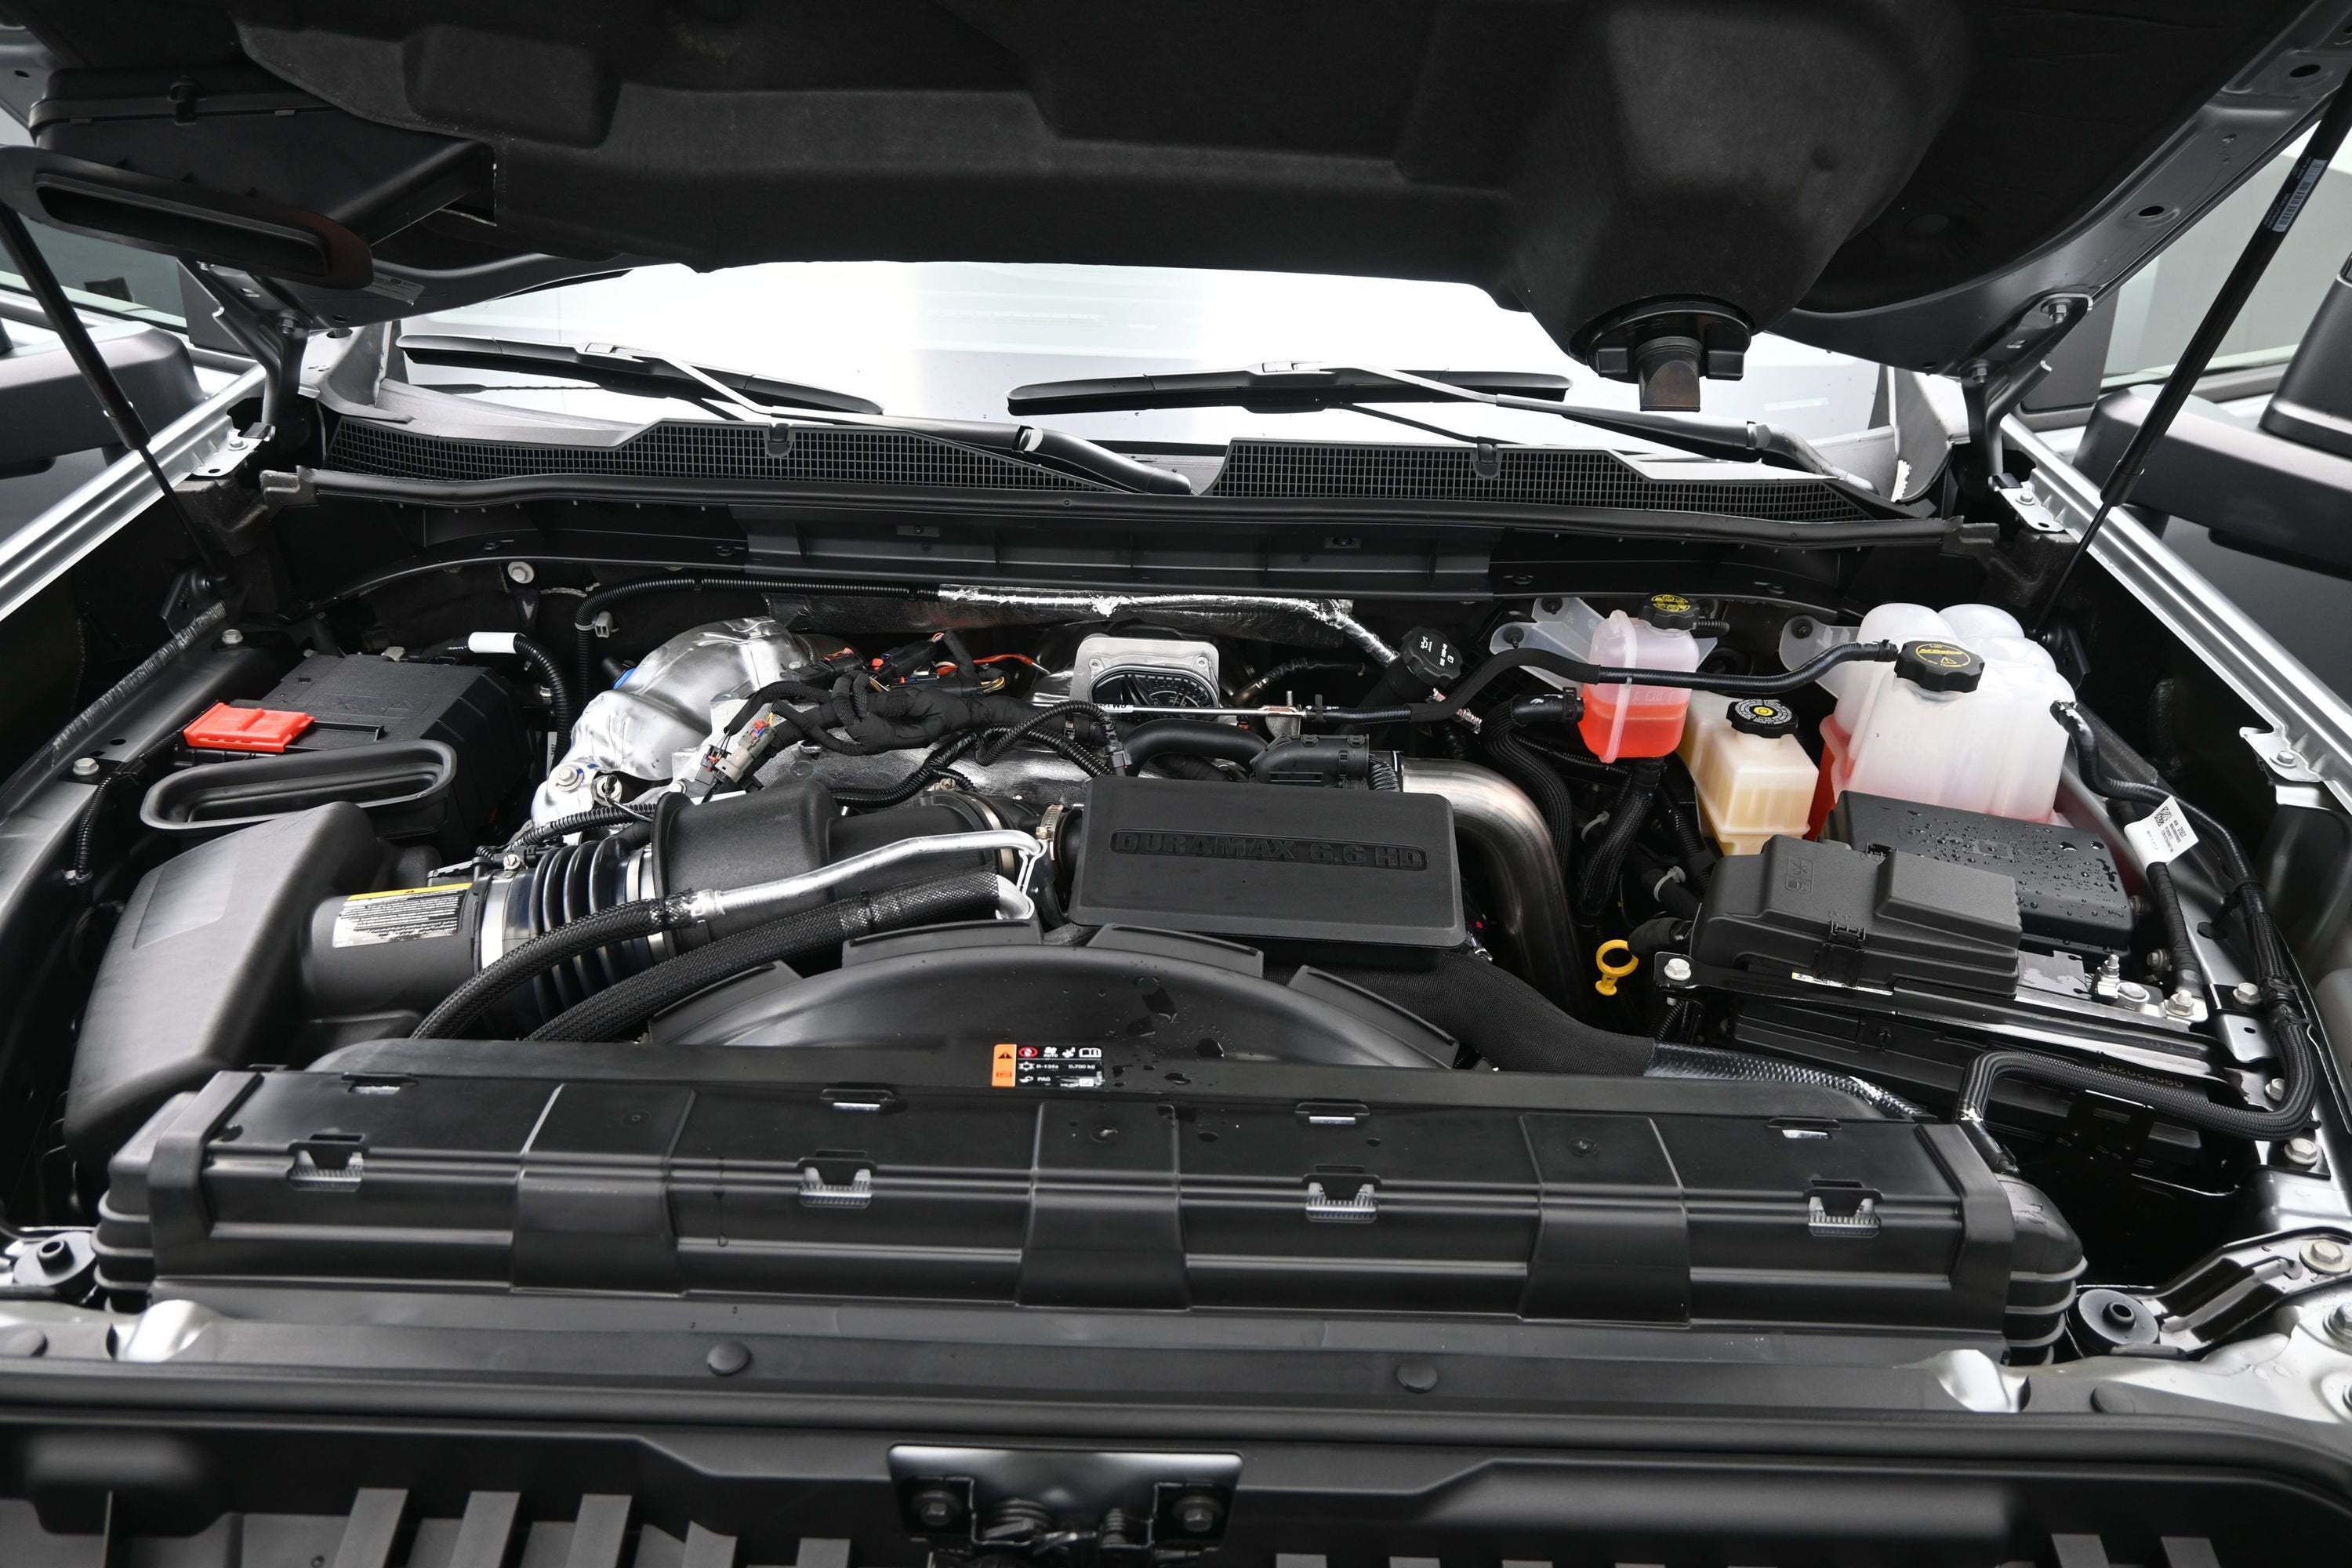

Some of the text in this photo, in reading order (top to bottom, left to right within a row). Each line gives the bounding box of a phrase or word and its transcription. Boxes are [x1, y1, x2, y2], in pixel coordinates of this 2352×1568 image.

[1116, 833, 1425, 869] DURAMAX 6.6 HD
